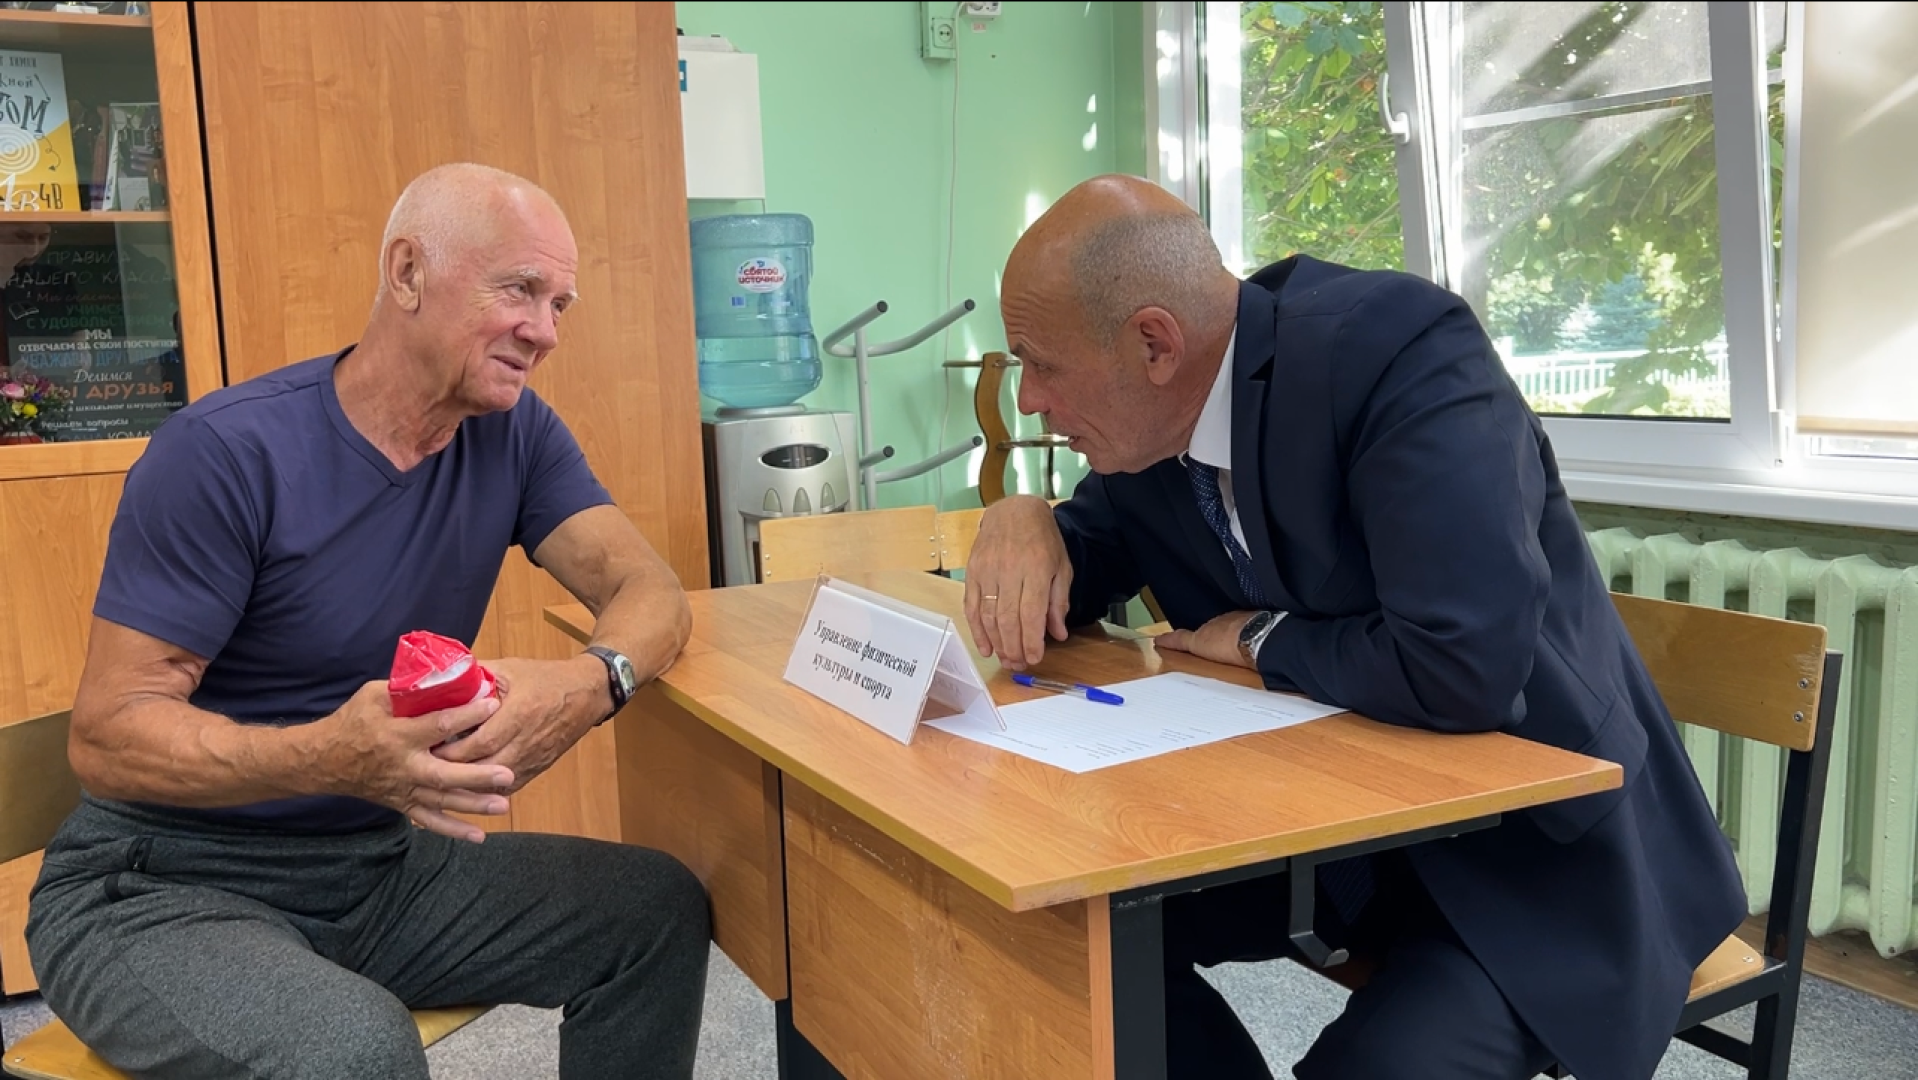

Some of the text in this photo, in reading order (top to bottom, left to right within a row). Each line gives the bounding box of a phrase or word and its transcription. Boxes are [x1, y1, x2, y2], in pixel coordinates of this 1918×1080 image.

[85, 329, 112, 340] МЫ
[73, 368, 133, 383] Делимся
[814, 620, 862, 653] Управление
[861, 640, 918, 677] физической
[813, 653, 853, 682] культуры
[861, 675, 893, 700] спорта
